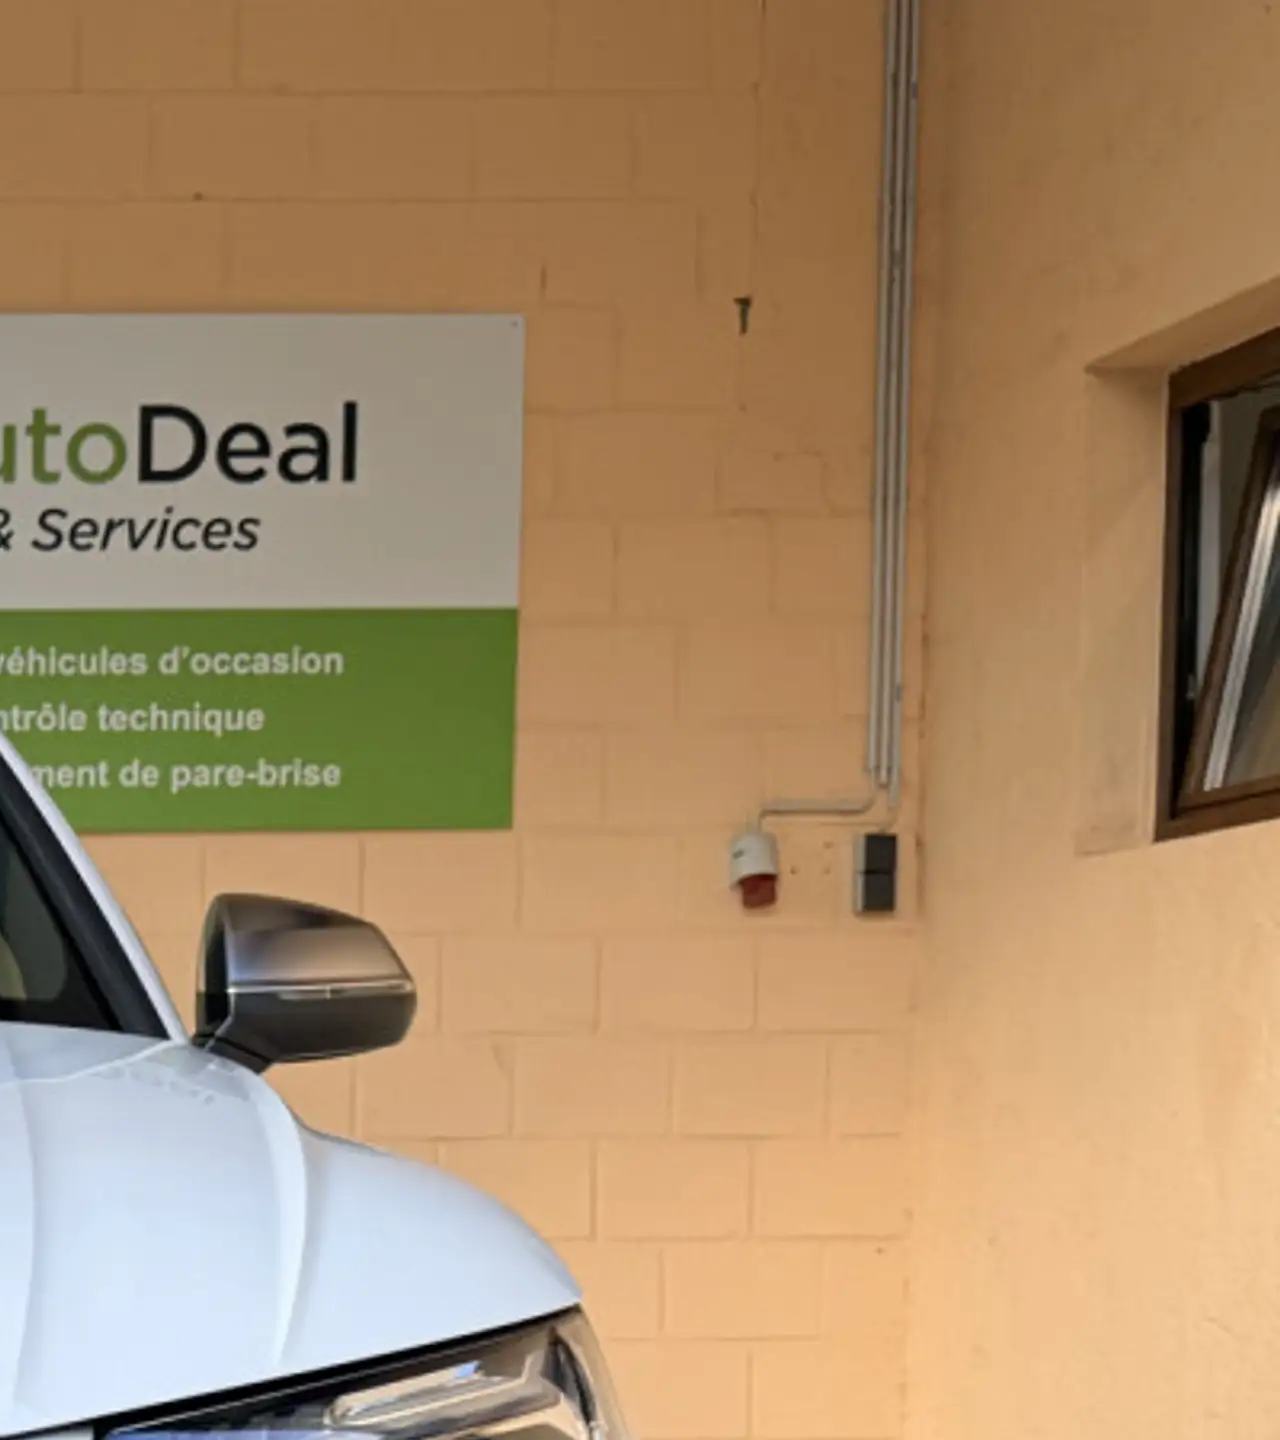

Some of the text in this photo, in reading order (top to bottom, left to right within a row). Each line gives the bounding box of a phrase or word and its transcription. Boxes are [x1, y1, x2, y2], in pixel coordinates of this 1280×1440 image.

[31, 506, 261, 553] Services
[158, 645, 344, 677] d'occasion
[97, 702, 266, 739] technique
[29, 757, 342, 795] ment de pare-brise
